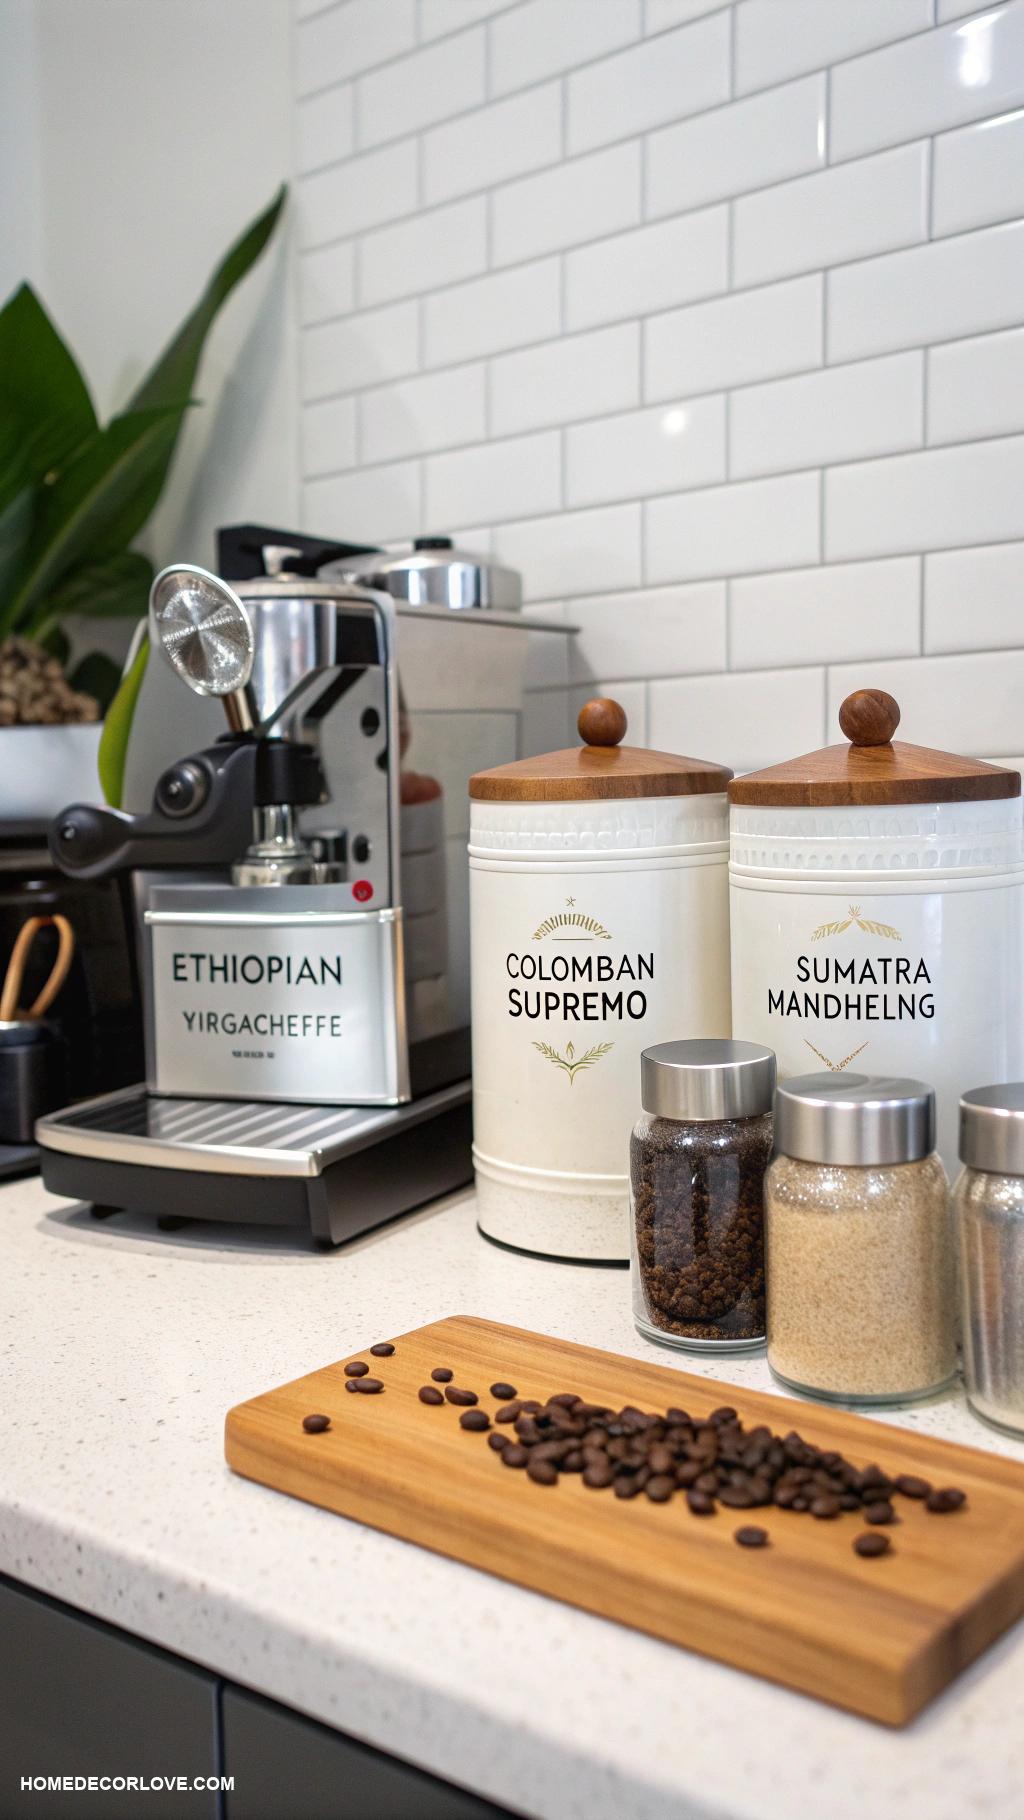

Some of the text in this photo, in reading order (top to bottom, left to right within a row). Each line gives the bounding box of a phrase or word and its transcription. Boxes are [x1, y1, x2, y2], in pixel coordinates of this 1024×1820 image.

[172, 953, 342, 985] ETHIOPIAN
[506, 952, 654, 982] COLOMBAN
[796, 956, 931, 984] SUMATRA
[508, 988, 647, 1021] SUPREMO
[768, 988, 935, 1020] MANDHELNG
[183, 1011, 342, 1037] YIRGACHEFFE
